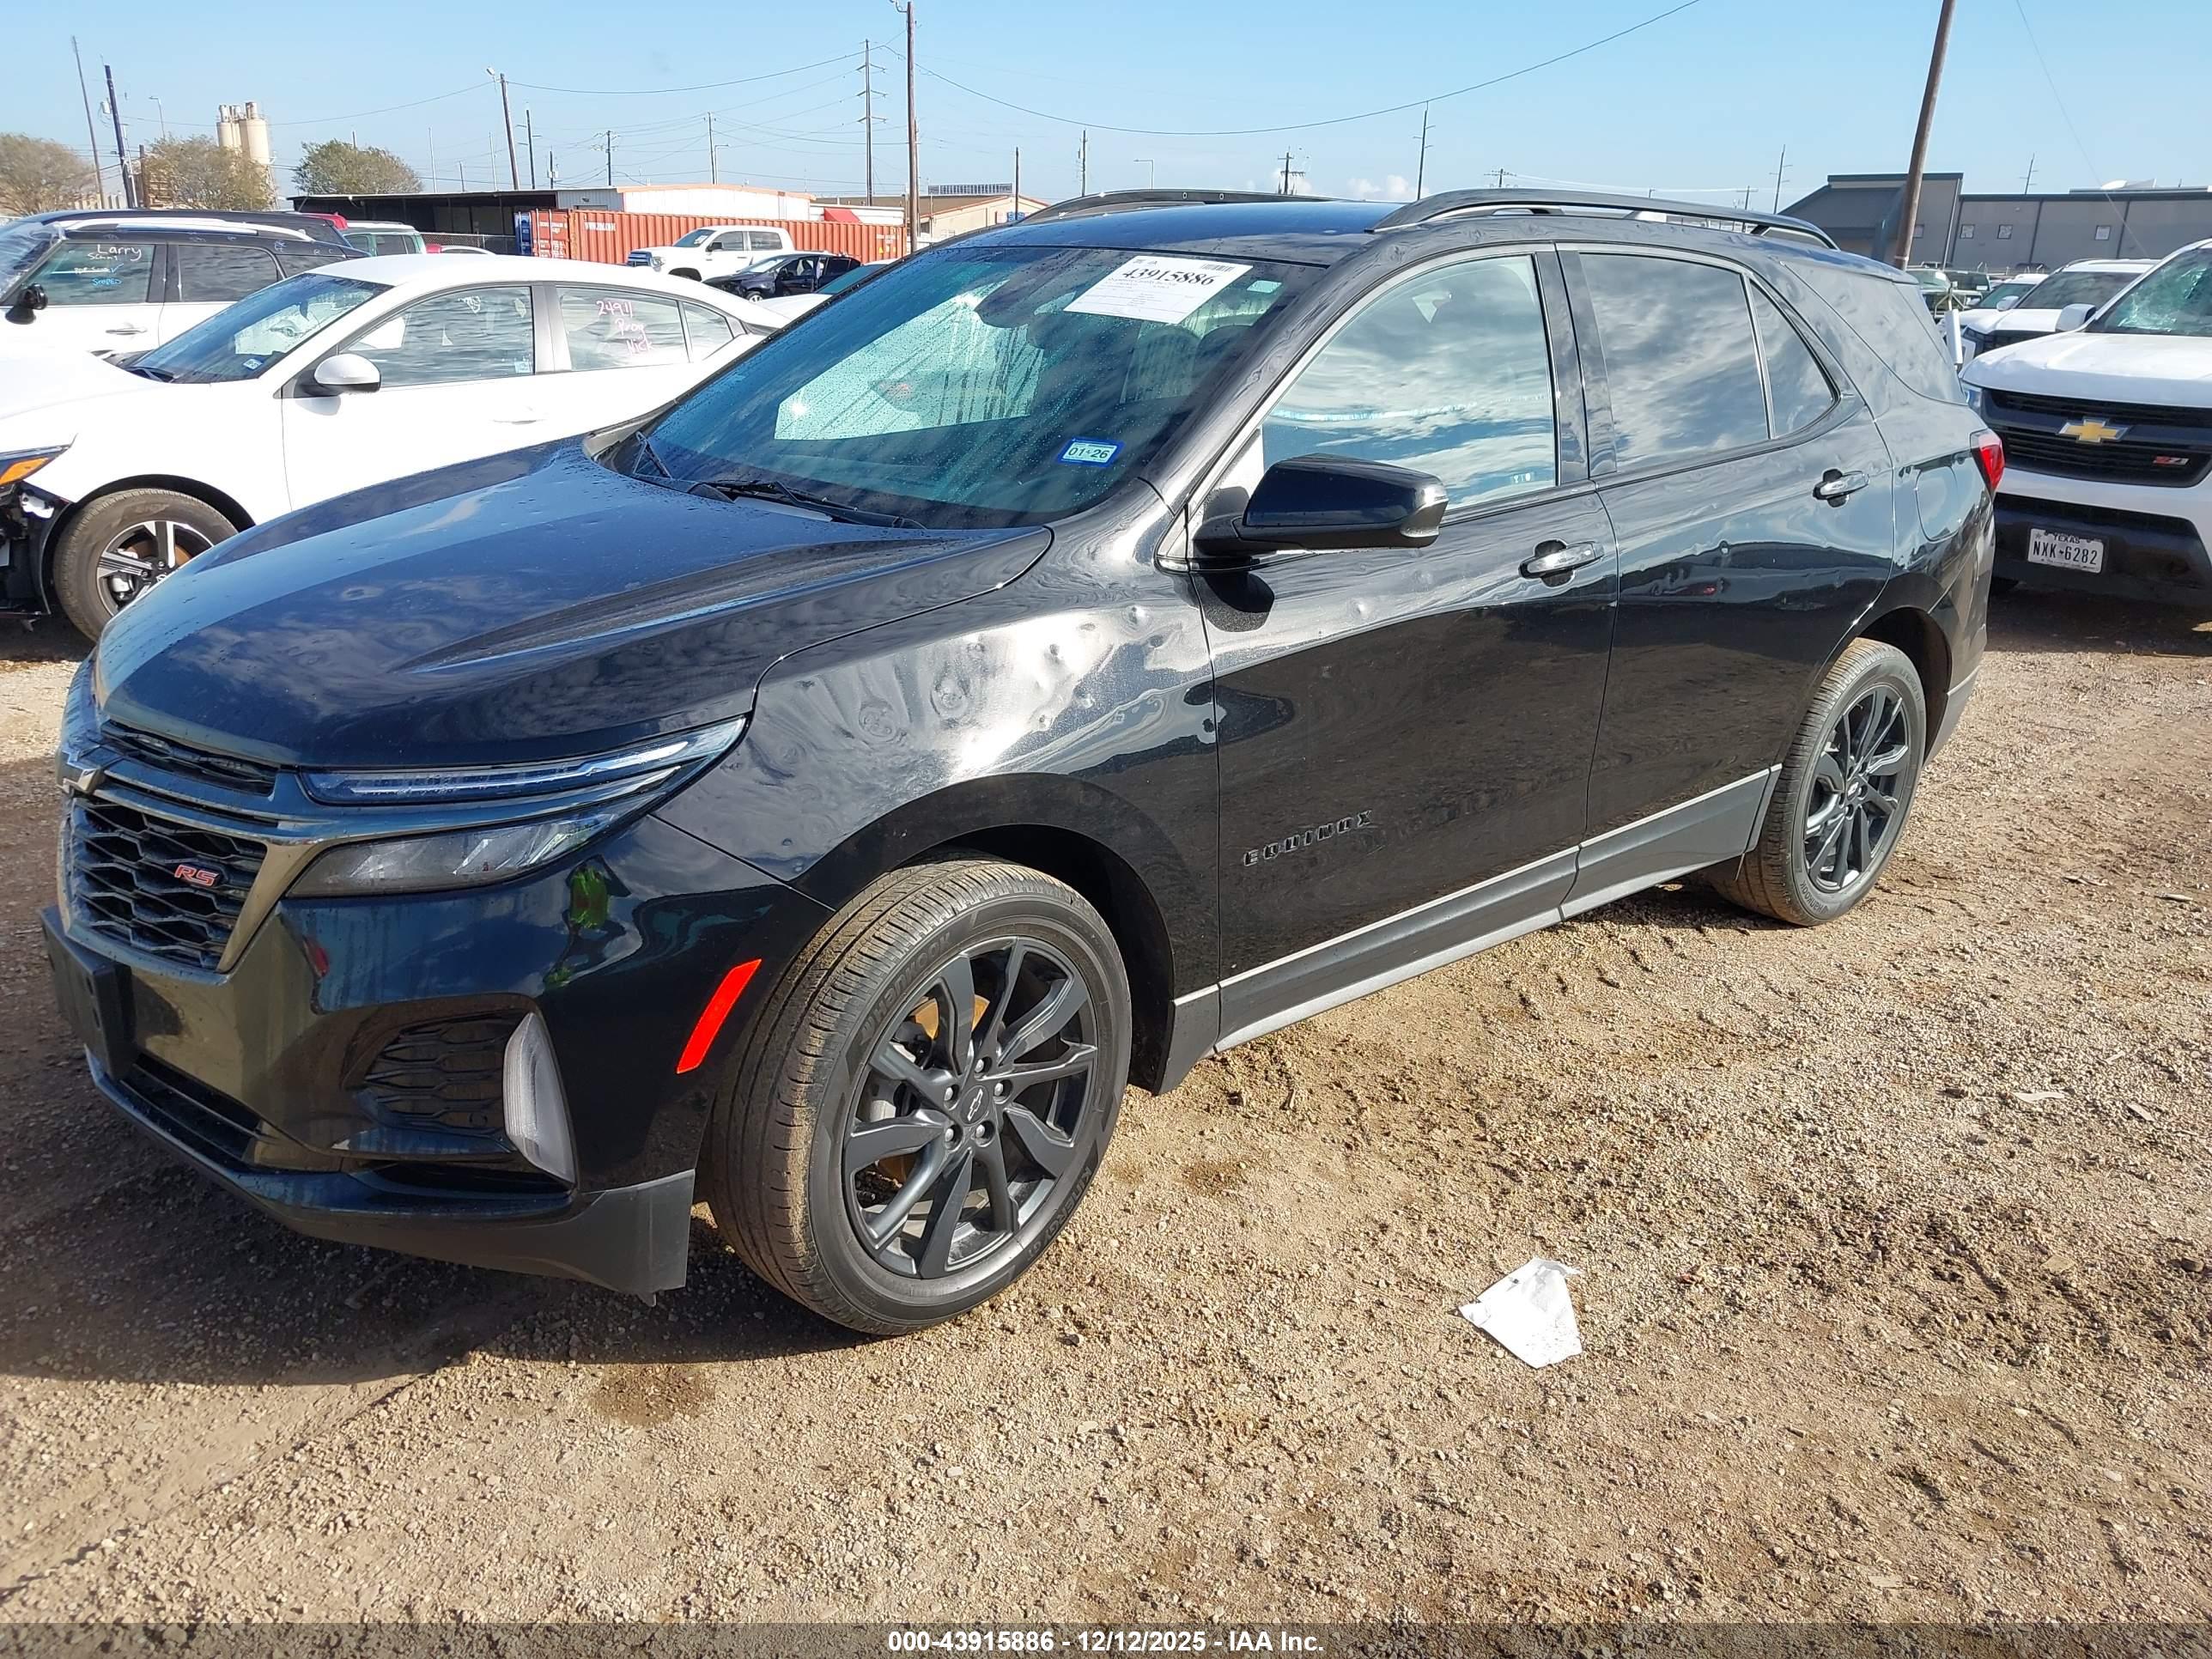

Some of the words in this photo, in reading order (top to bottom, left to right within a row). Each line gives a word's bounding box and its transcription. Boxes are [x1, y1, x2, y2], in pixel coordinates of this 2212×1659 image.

[96, 244, 143, 261] Larry
[1122, 267, 1217, 286] 43915886
[1068, 447, 1086, 457] 01
[1090, 449, 1110, 459] 26
[1243, 810, 1373, 866] EQUINOX
[173, 864, 220, 886] RS
